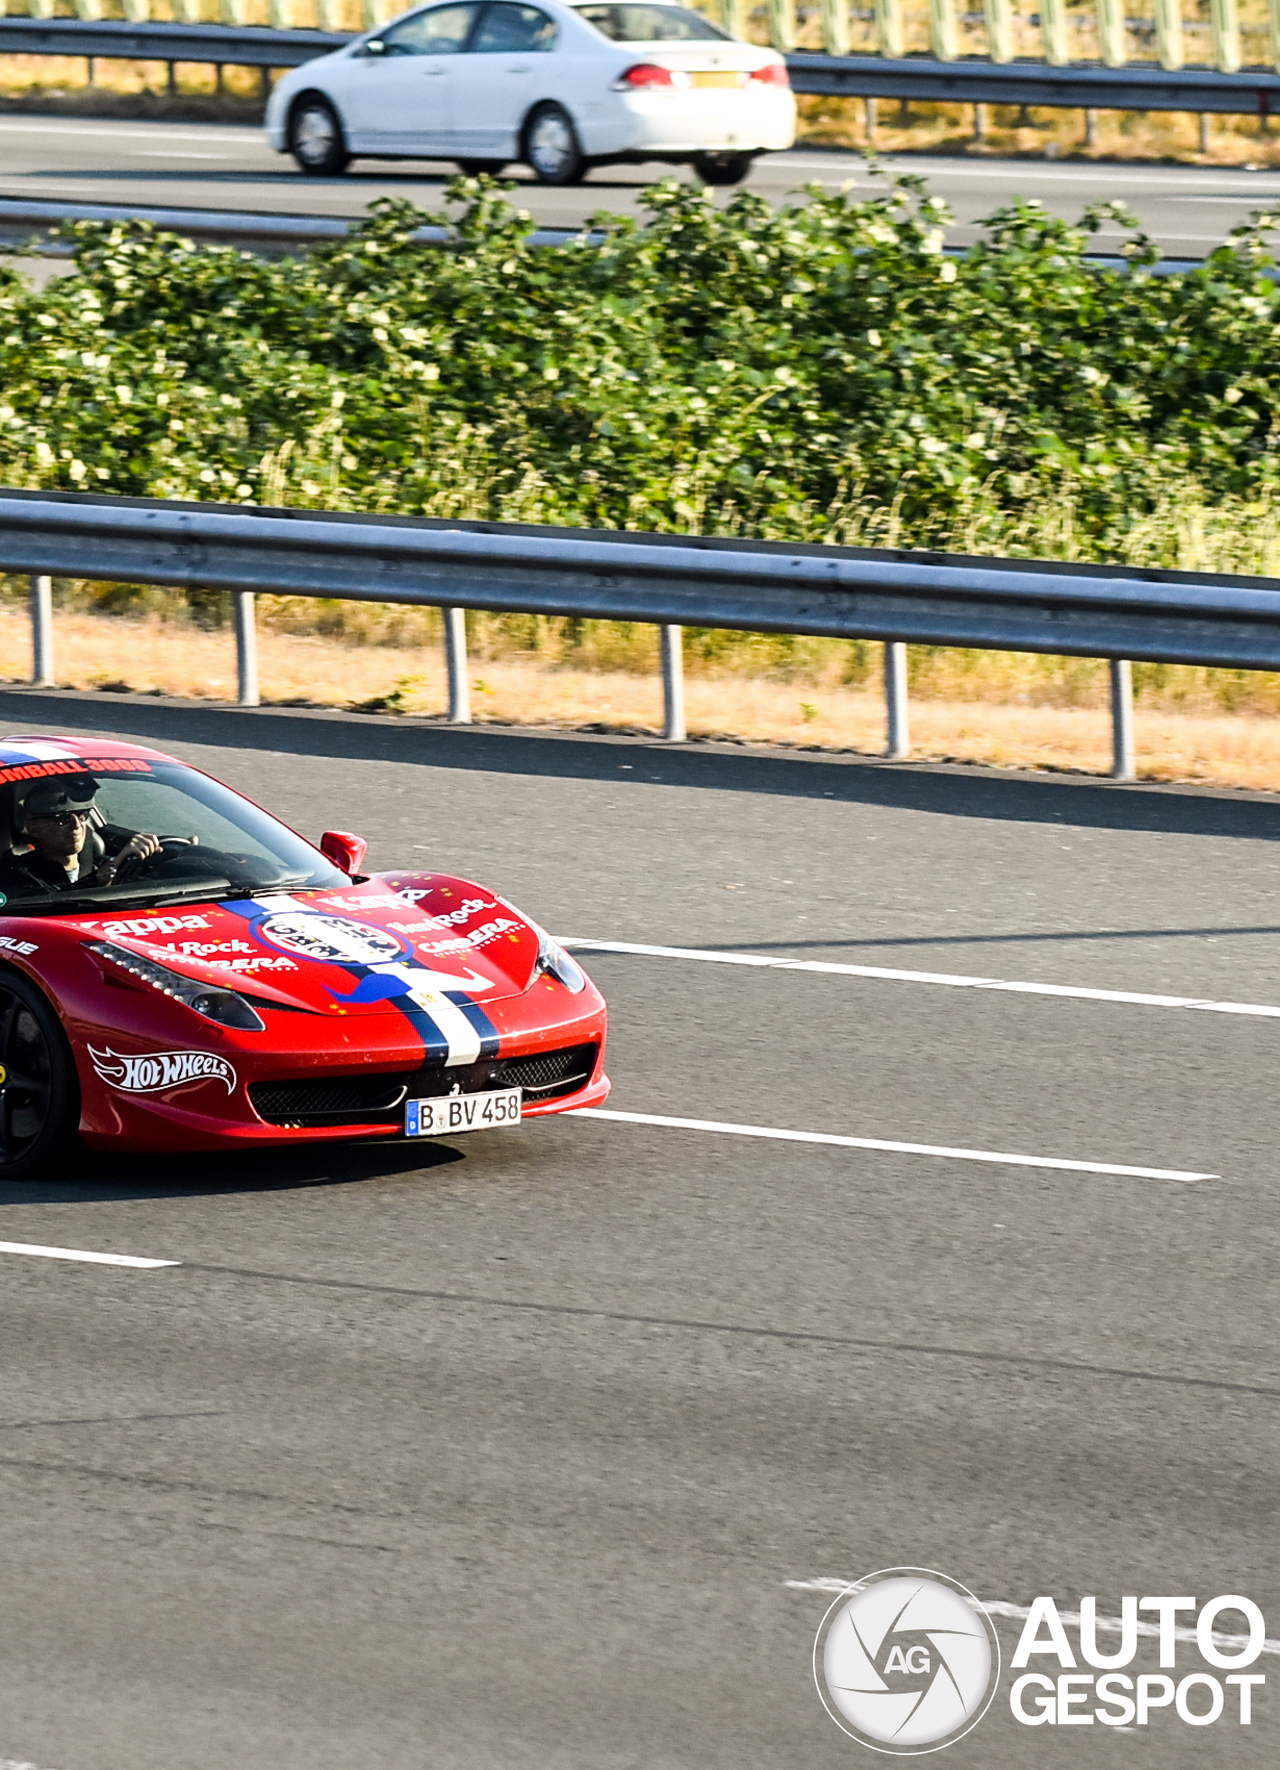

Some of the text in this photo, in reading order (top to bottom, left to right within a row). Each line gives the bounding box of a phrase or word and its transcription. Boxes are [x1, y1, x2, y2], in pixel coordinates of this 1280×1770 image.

[83, 758, 151, 773] 3000
[432, 899, 497, 927] Rock
[179, 939, 254, 956] Rock
[418, 918, 519, 953] CARRERA
[420, 1095, 519, 1130] B BV 458
